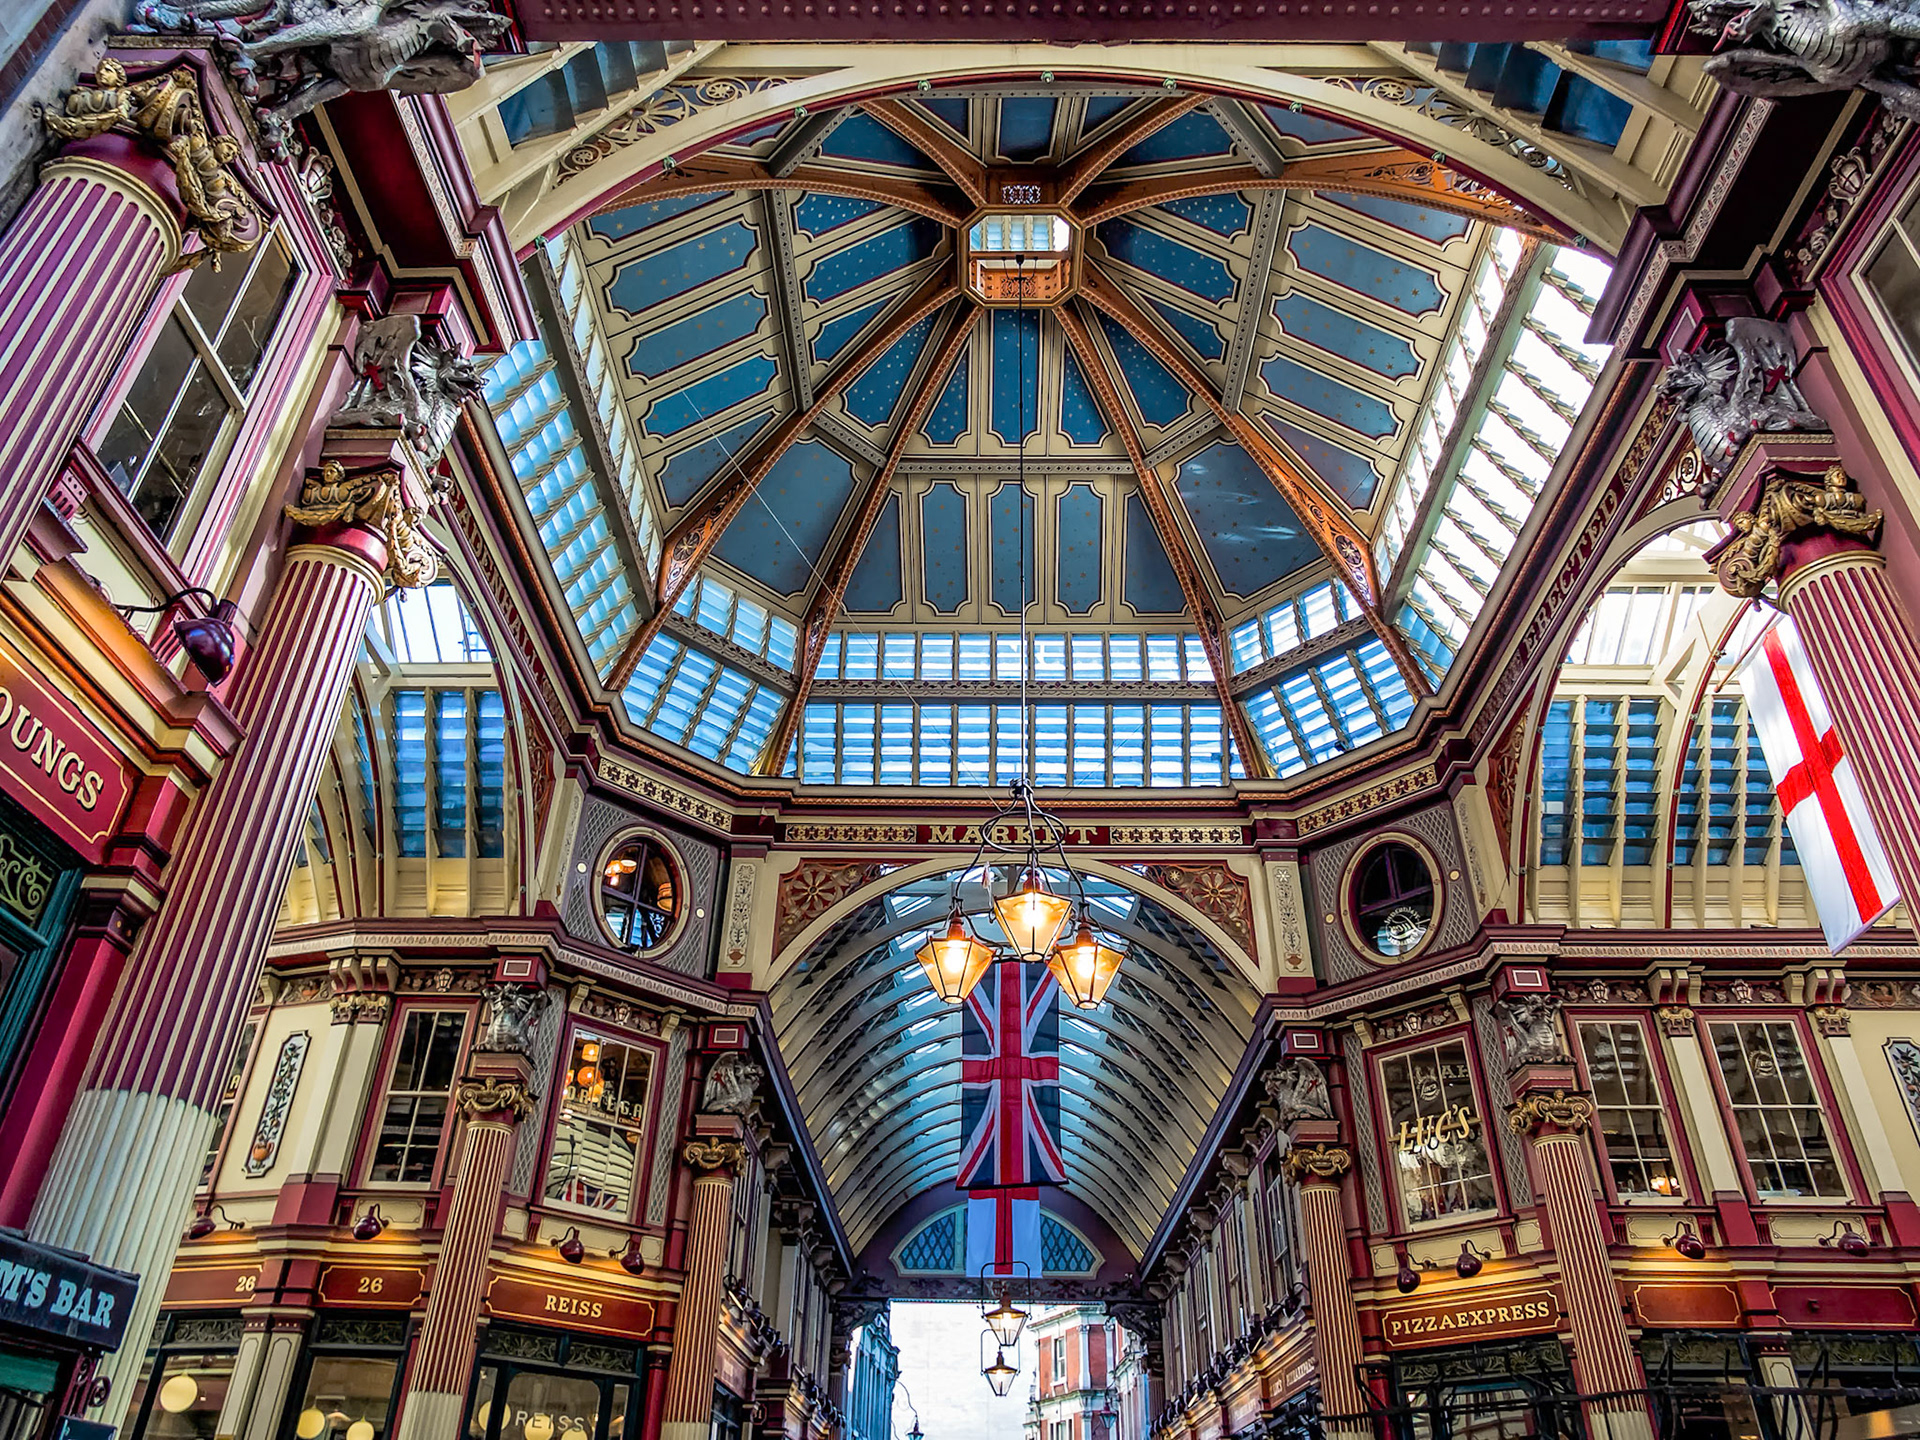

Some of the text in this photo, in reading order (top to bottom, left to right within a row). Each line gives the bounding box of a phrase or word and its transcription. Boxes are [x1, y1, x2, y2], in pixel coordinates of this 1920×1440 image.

[440, 457, 546, 678] EADENHALL
[1523, 489, 1618, 659] ERECTED
[927, 825, 1098, 844] MARKET
[1399, 1104, 1471, 1151] LUC'S
[235, 1276, 256, 1292] 26
[358, 1277, 383, 1293] 26
[50, 1279, 115, 1328] BAR
[545, 1295, 603, 1318] REISS
[1391, 1301, 1550, 1336] PIZZAEXPRESS
[515, 1410, 585, 1432] REISS
